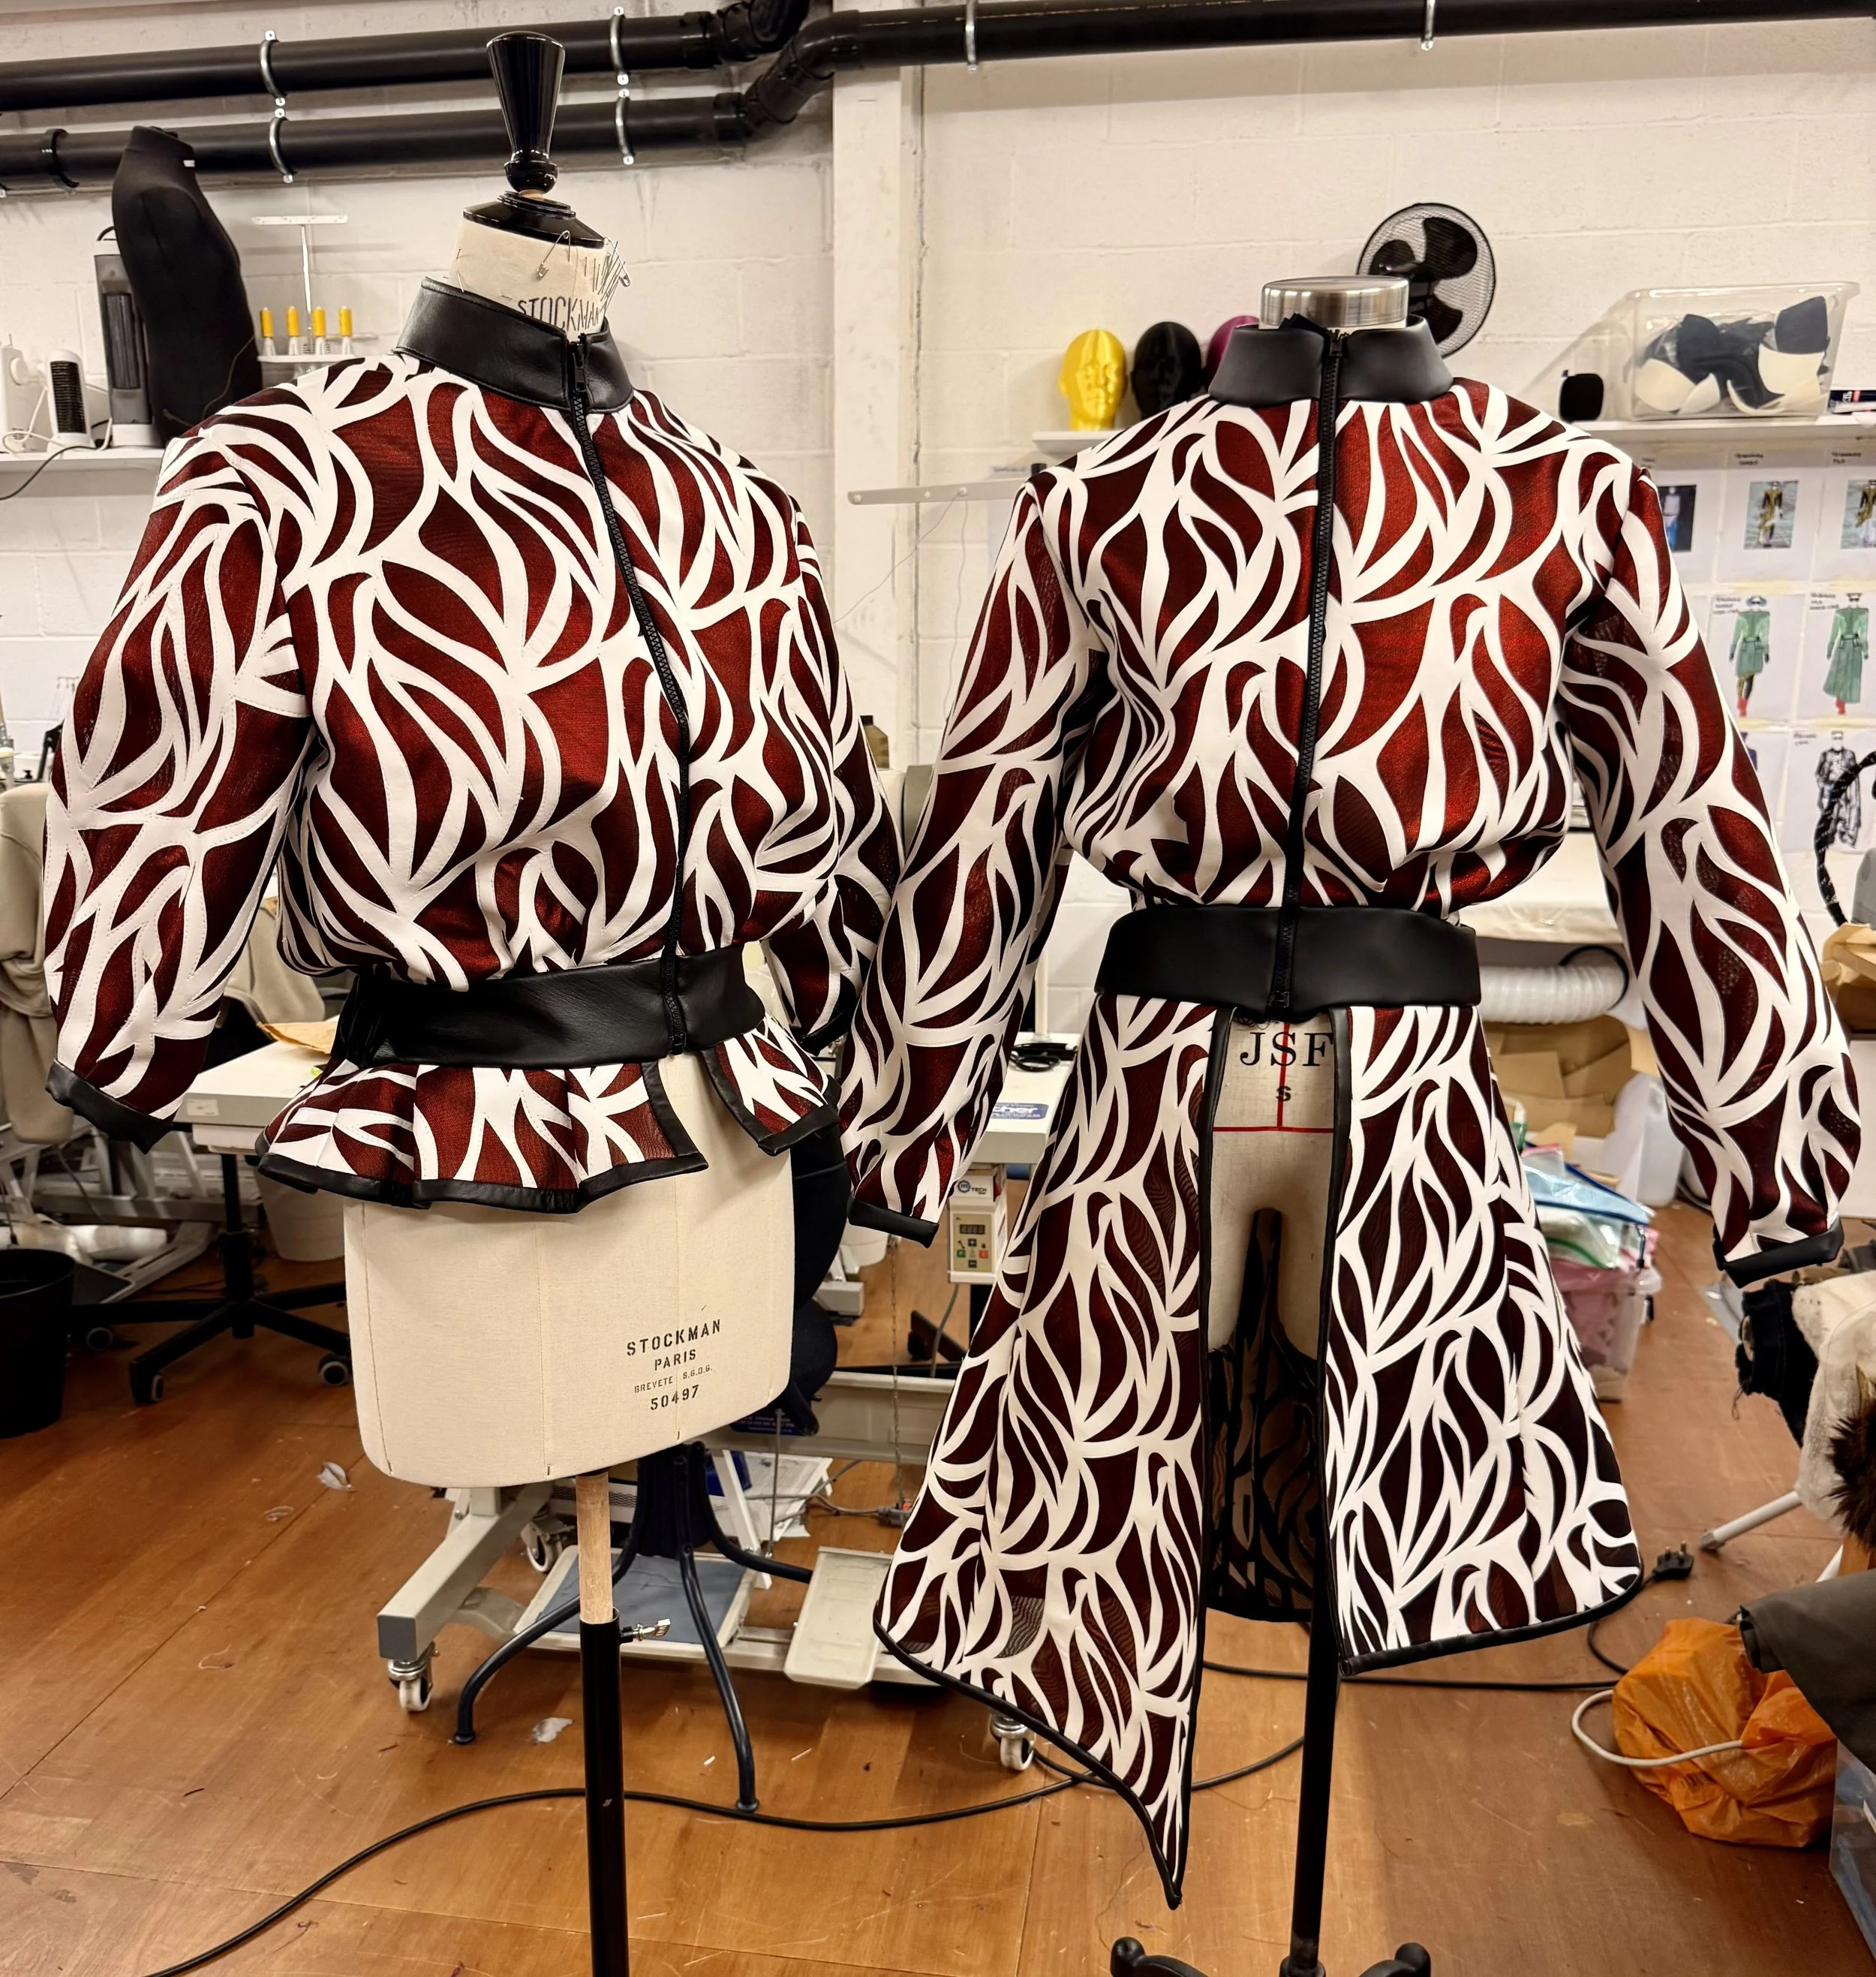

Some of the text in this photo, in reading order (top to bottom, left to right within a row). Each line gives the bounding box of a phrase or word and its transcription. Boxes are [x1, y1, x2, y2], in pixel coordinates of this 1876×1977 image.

[1240, 1032, 1333, 1067] JSF
[627, 1319, 721, 1356] STOCKMAN
[654, 1349, 696, 1371] PARIS
[650, 1384, 699, 1411] 50497
